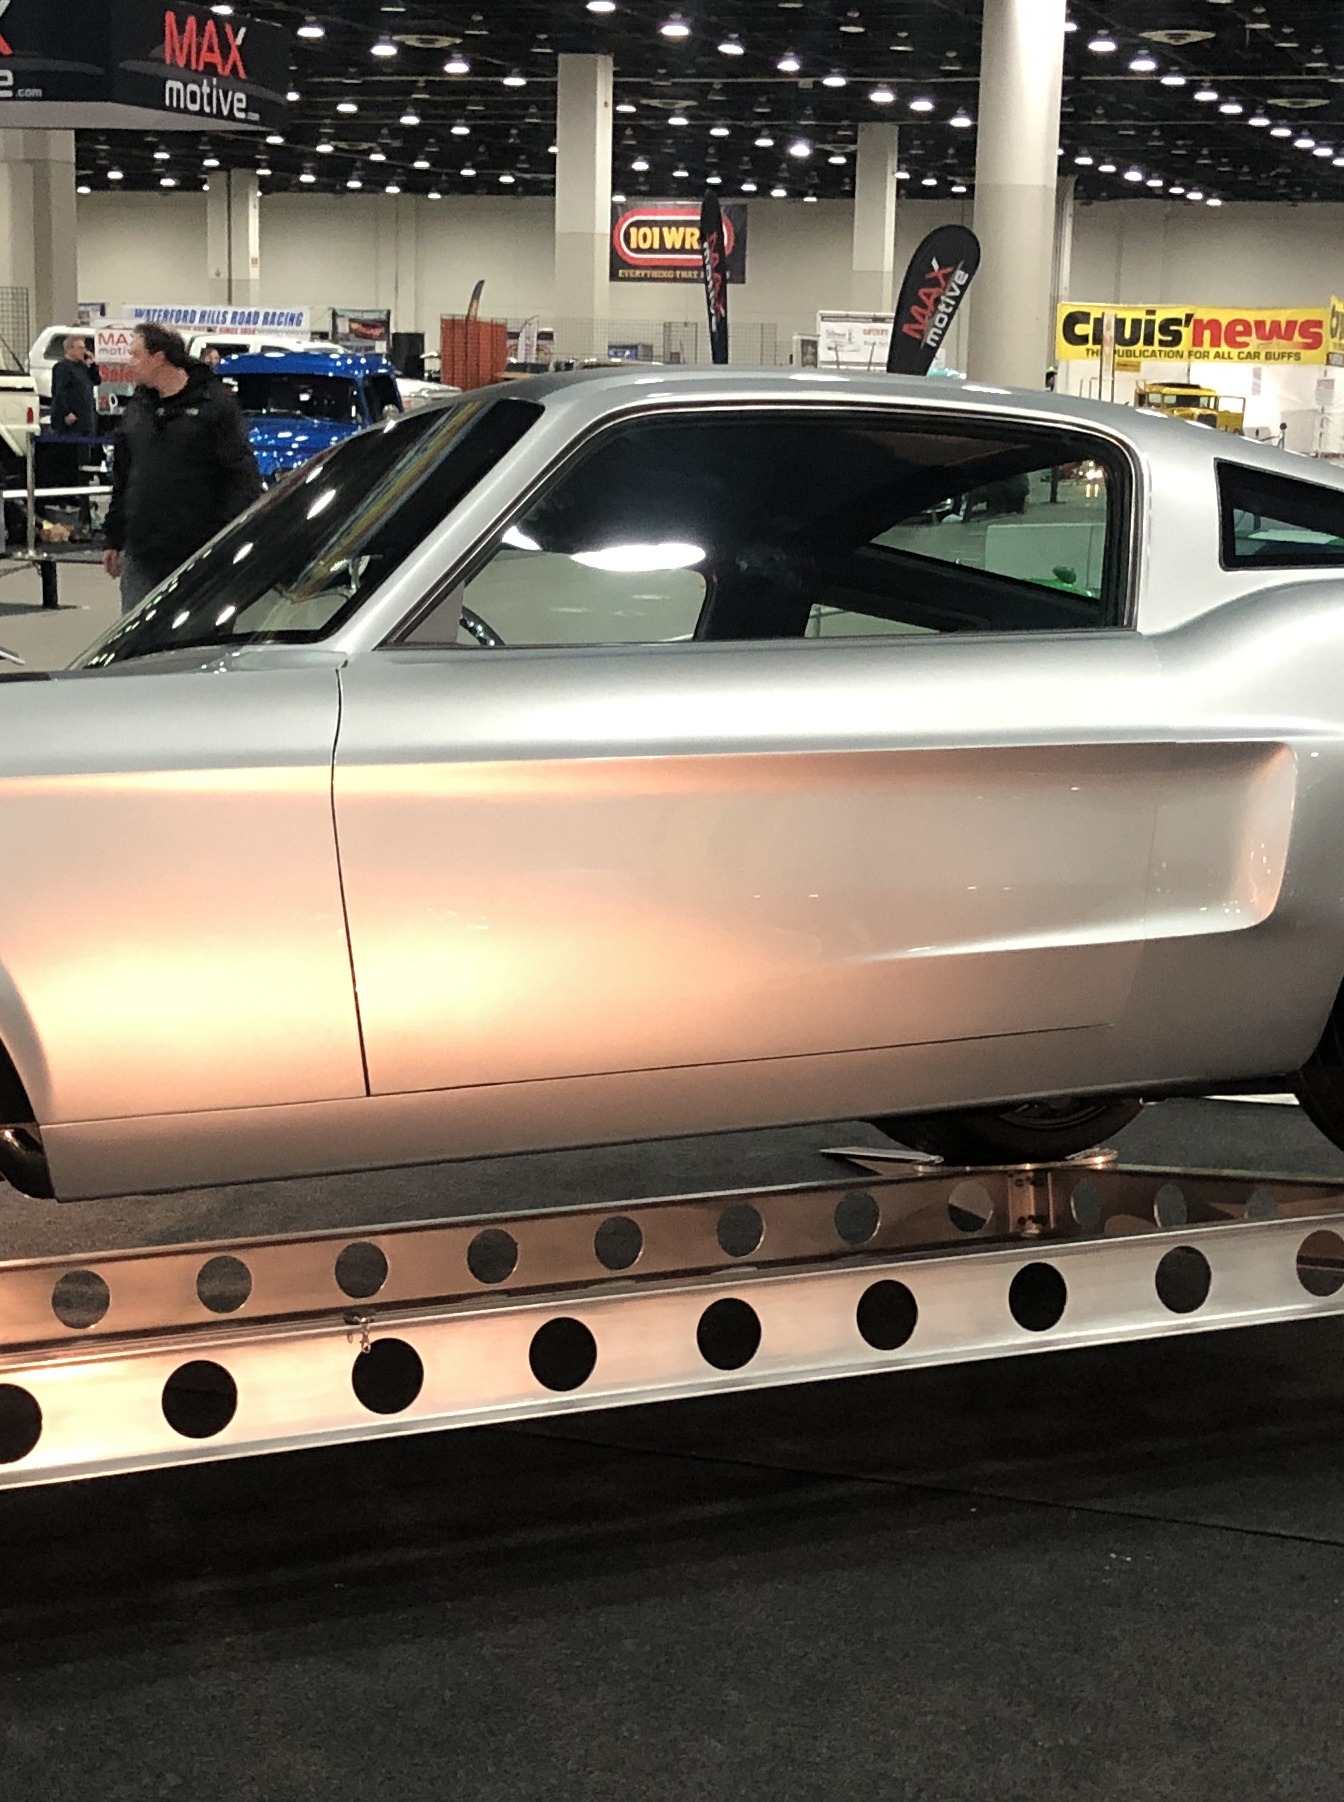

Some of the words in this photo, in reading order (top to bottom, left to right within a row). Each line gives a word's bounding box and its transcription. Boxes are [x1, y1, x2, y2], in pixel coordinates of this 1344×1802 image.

[164, 10, 247, 80] MAX
[134, 308, 197, 324] WATERFORD
[198, 309, 229, 325] HILLS
[229, 310, 260, 326] ROAD
[261, 311, 304, 327] RACING
[901, 256, 955, 340] MAX
[926, 269, 969, 348] motive
[97, 332, 129, 346] MA
[1085, 348, 1102, 358] TH
[1187, 351, 1210, 360] FOR
[1213, 351, 1234, 360] ALL
[1237, 351, 1261, 361] CAR
[1264, 351, 1302, 361] BUFFS
